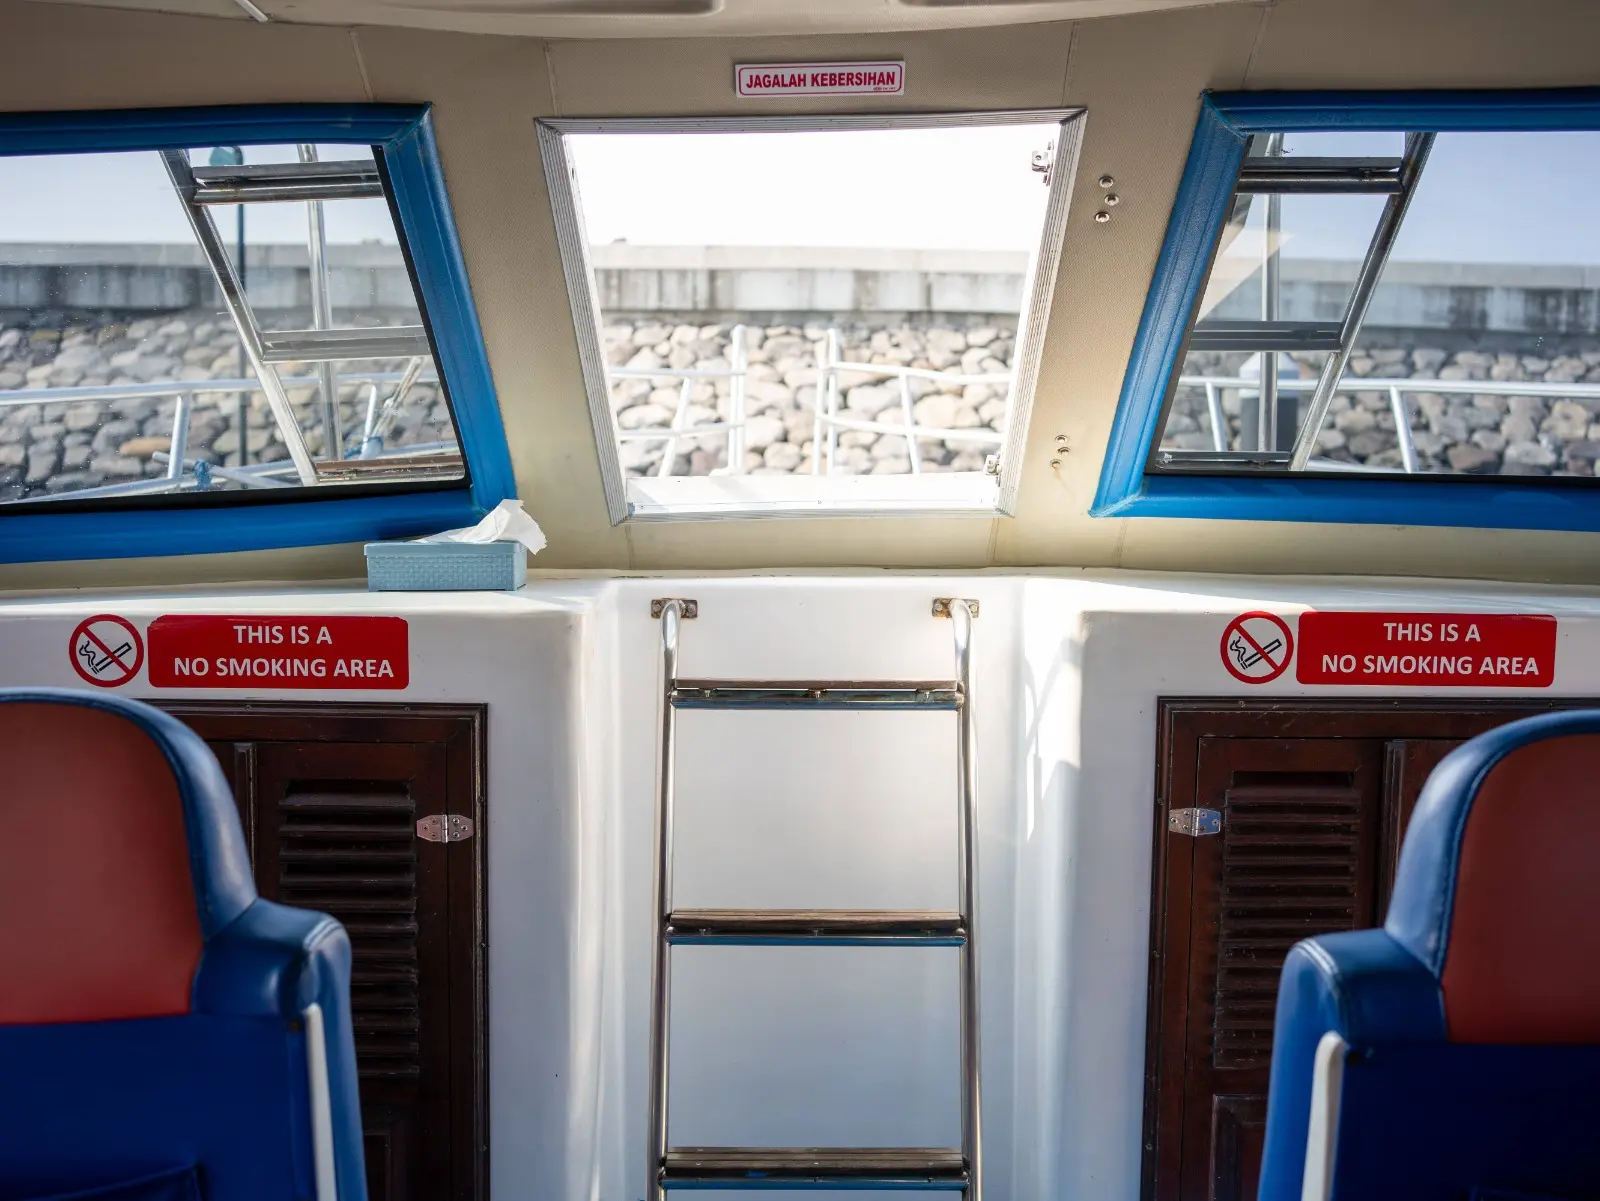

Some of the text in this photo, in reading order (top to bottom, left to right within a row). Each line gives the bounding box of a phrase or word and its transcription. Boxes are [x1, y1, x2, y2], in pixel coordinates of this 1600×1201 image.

[746, 71, 896, 89] JAGALAH KEBERSIHAN
[233, 625, 333, 645] THIS IS A
[1383, 622, 1481, 642] THIS IS A
[174, 657, 394, 678] NO SMOKING AREA
[1322, 654, 1539, 675] NO SMOKING AREA
